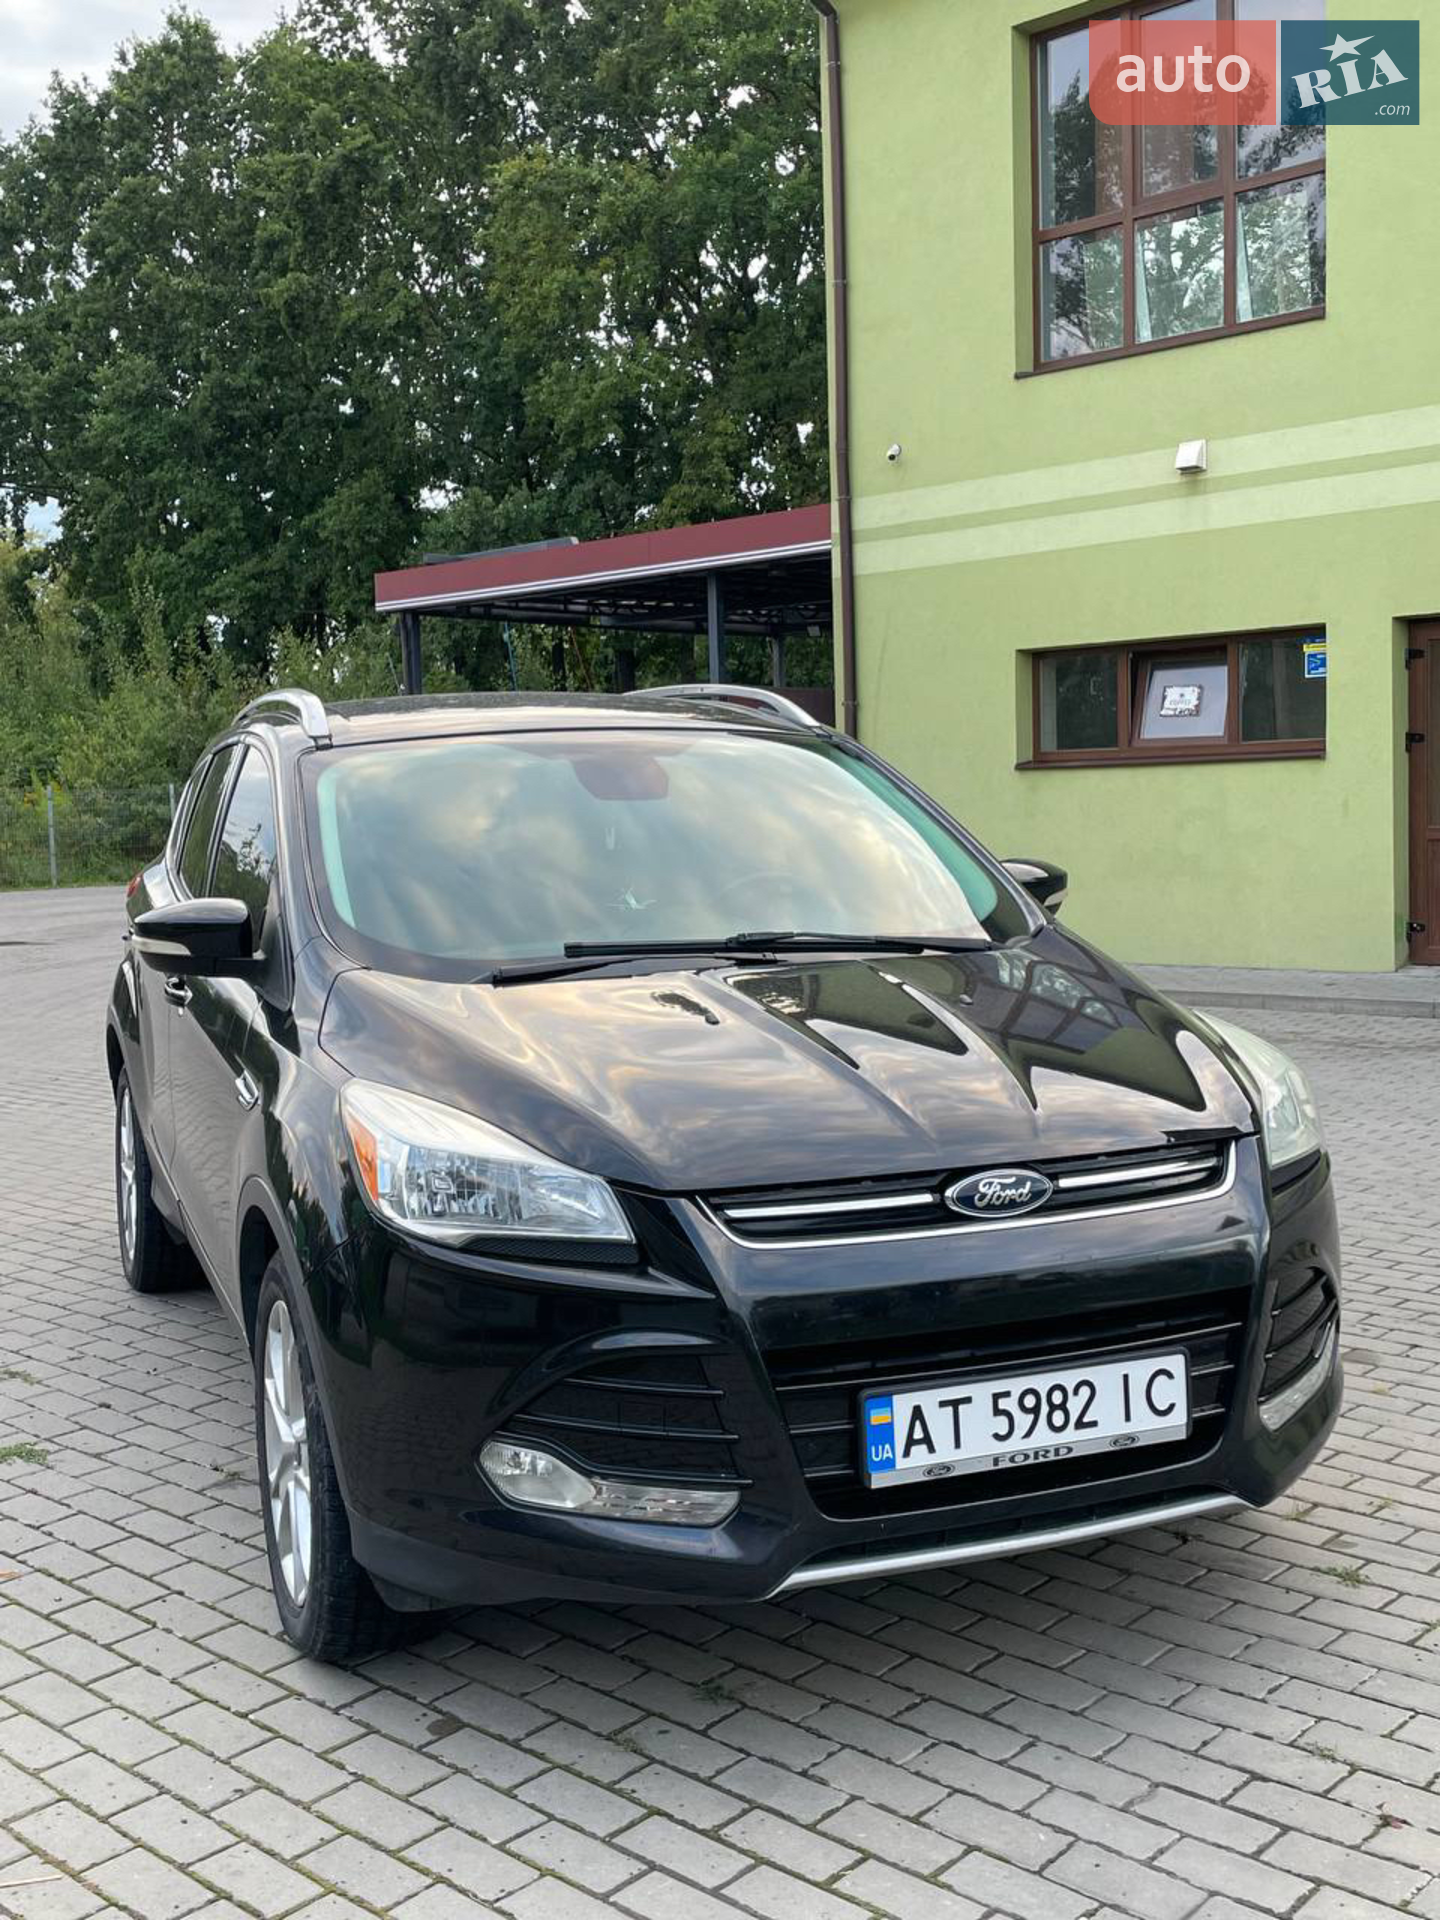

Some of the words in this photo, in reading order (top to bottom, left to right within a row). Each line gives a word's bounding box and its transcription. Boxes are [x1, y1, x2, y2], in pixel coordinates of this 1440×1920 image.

[974, 1176, 1032, 1208] Ford
[902, 1395, 973, 1459] AT
[991, 1379, 1099, 1442] 5982
[1122, 1368, 1177, 1423] IC
[871, 1443, 893, 1461] UA
[992, 1445, 1074, 1467] FORD
